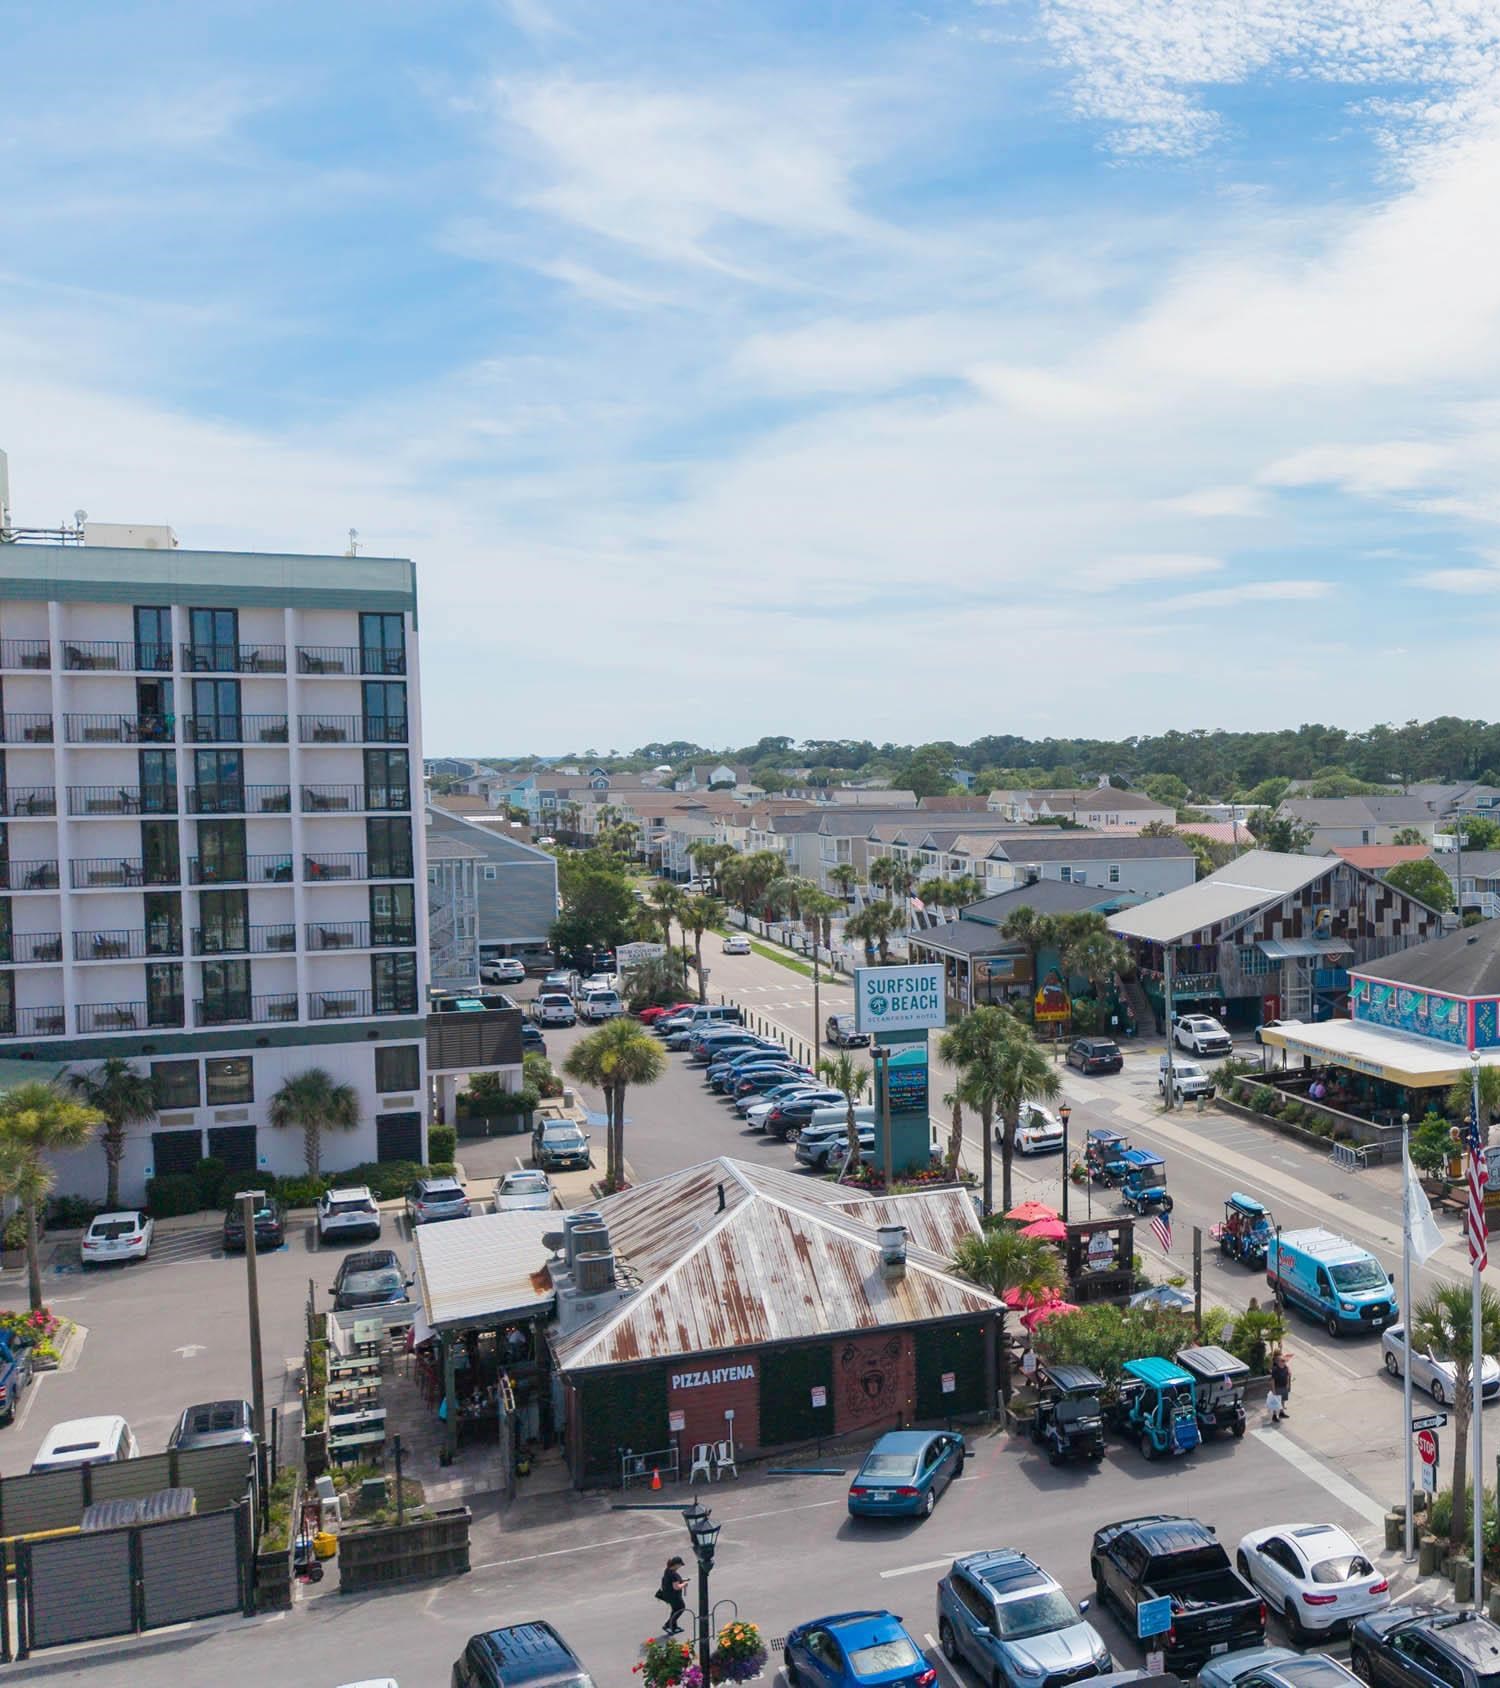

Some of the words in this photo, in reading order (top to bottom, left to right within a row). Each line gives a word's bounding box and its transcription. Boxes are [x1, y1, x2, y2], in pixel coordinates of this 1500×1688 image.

[867, 976, 937, 995] SURFSIDE
[891, 995, 938, 1011] BEACH
[868, 1015, 913, 1023] OCEANFRONT
[671, 1370, 711, 1390] PIZZA
[712, 1364, 755, 1384] HYENA
[1419, 1438, 1436, 1456] STOP
